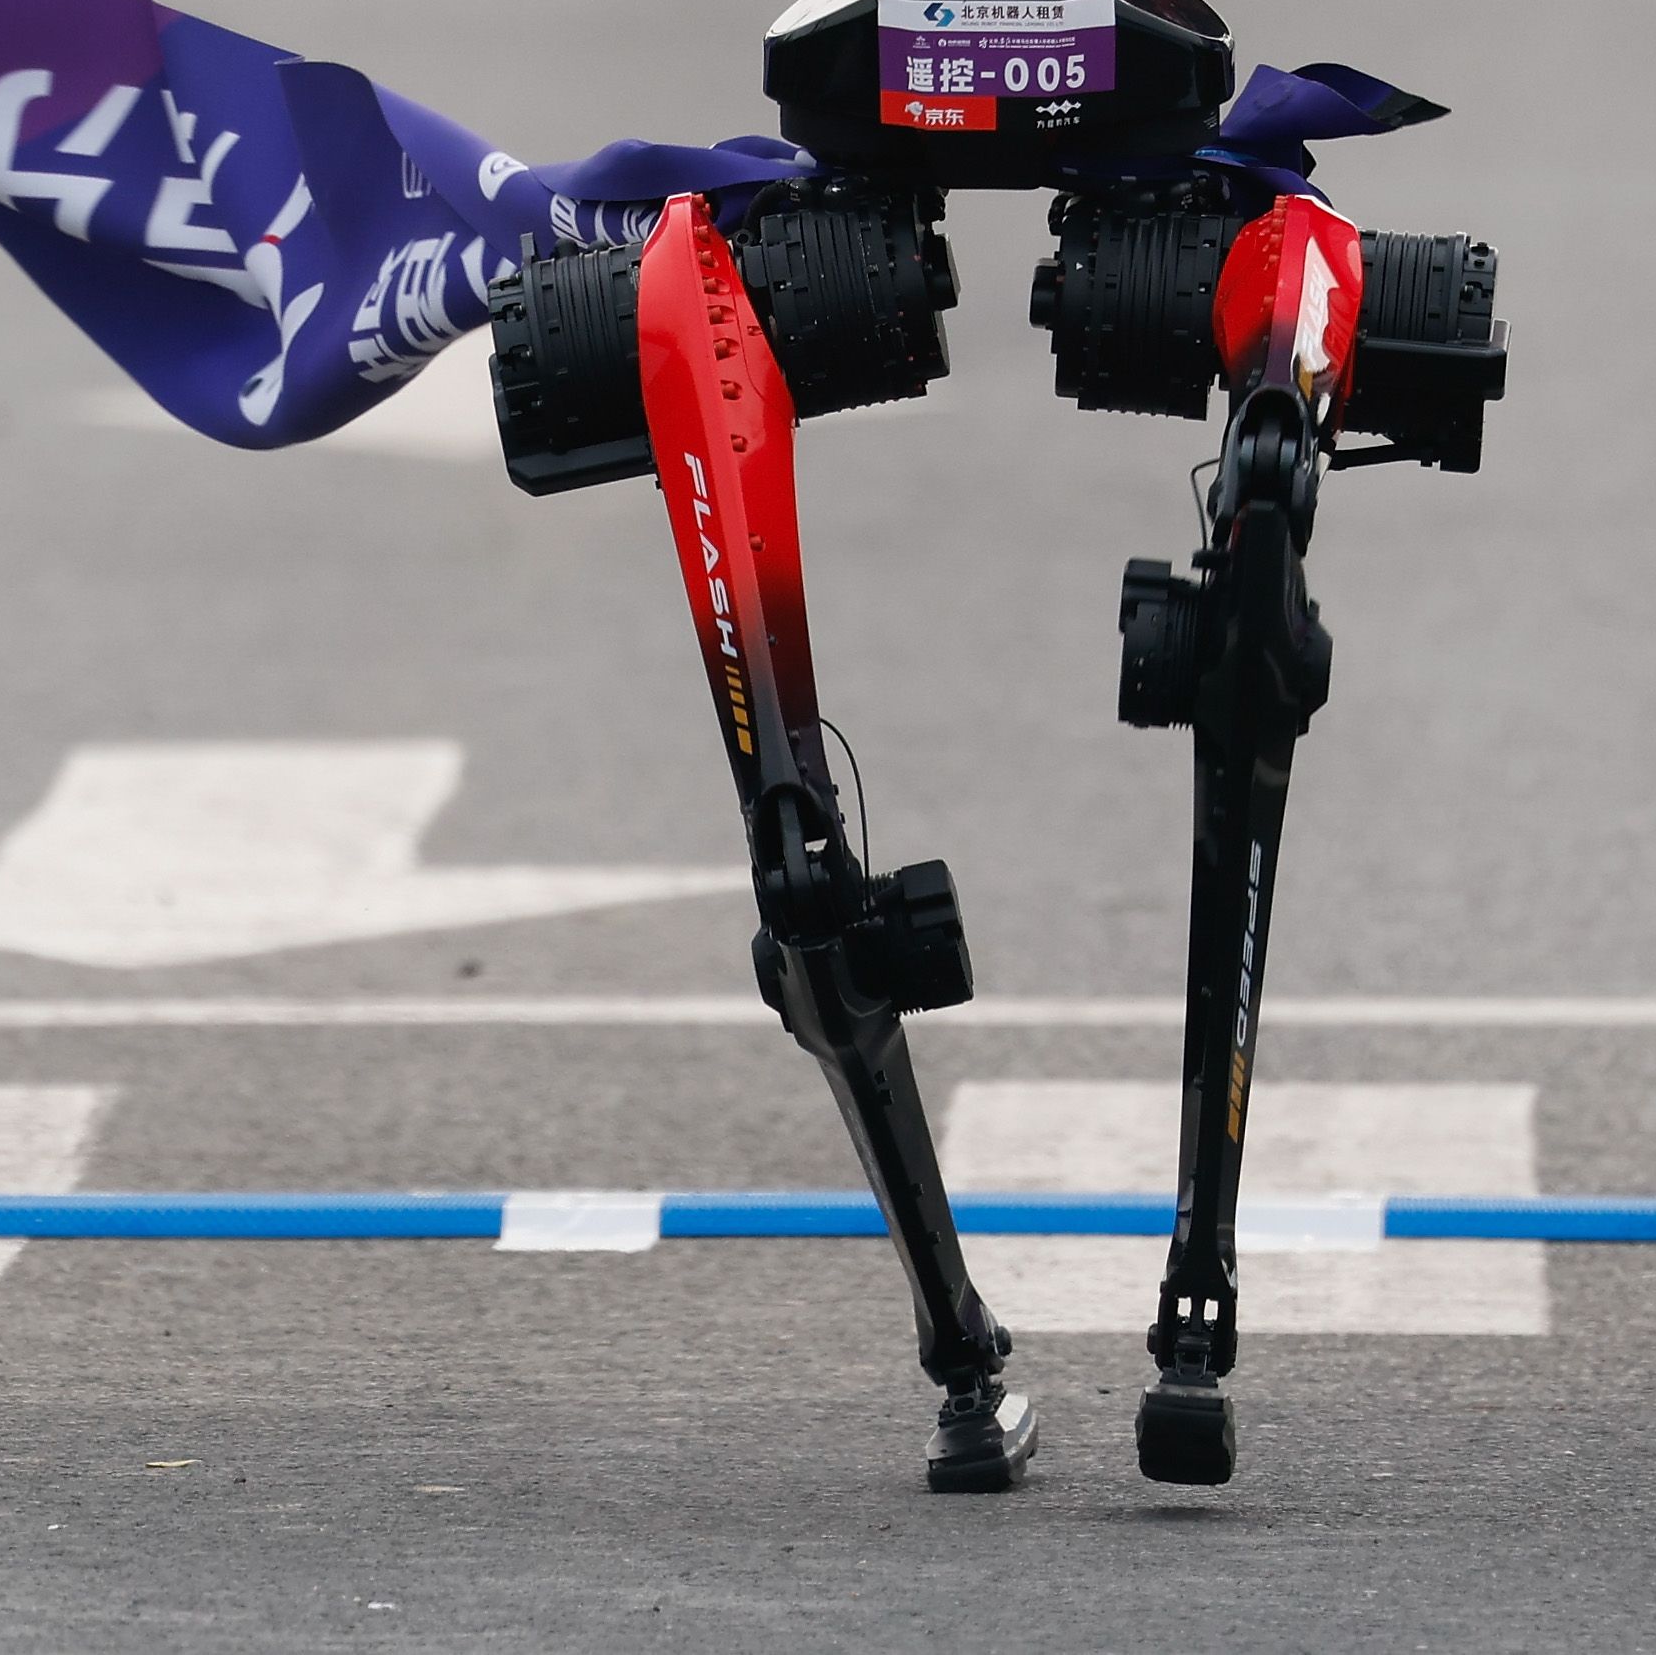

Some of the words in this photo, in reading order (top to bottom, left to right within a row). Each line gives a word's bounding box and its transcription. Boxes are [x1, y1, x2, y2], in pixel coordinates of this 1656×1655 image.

[960, 4, 1065, 20] 北京机器人租赁
[924, 107, 965, 127] 京东
[683, 450, 740, 659] FLASH
[1235, 838, 1263, 1049] SPEED
